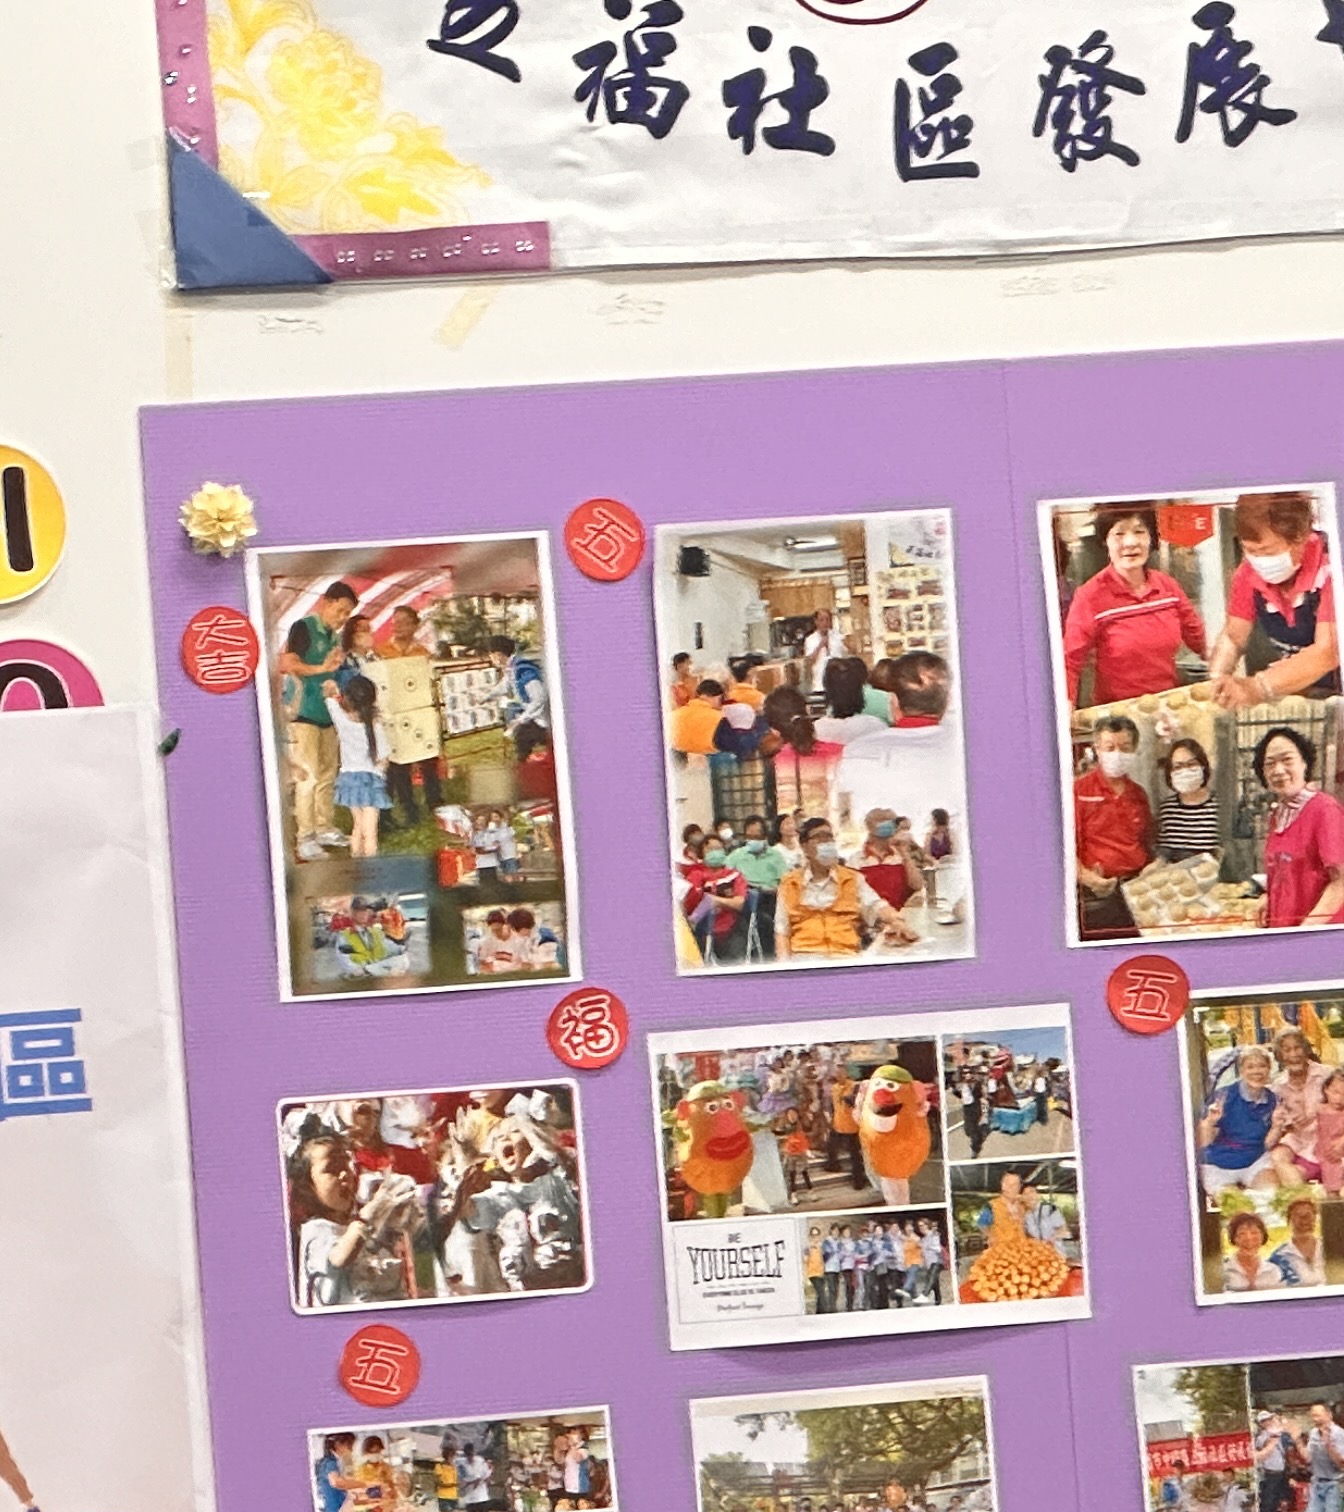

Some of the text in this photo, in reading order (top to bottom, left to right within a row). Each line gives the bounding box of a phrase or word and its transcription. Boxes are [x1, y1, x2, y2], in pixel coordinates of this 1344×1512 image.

[427, 0, 1344, 182] 福社區發展
[1121, 968, 1178, 1021] 五
[558, 994, 621, 1059] 福
[686, 1240, 786, 1286] YOURSELF
[348, 1336, 410, 1395] 五
